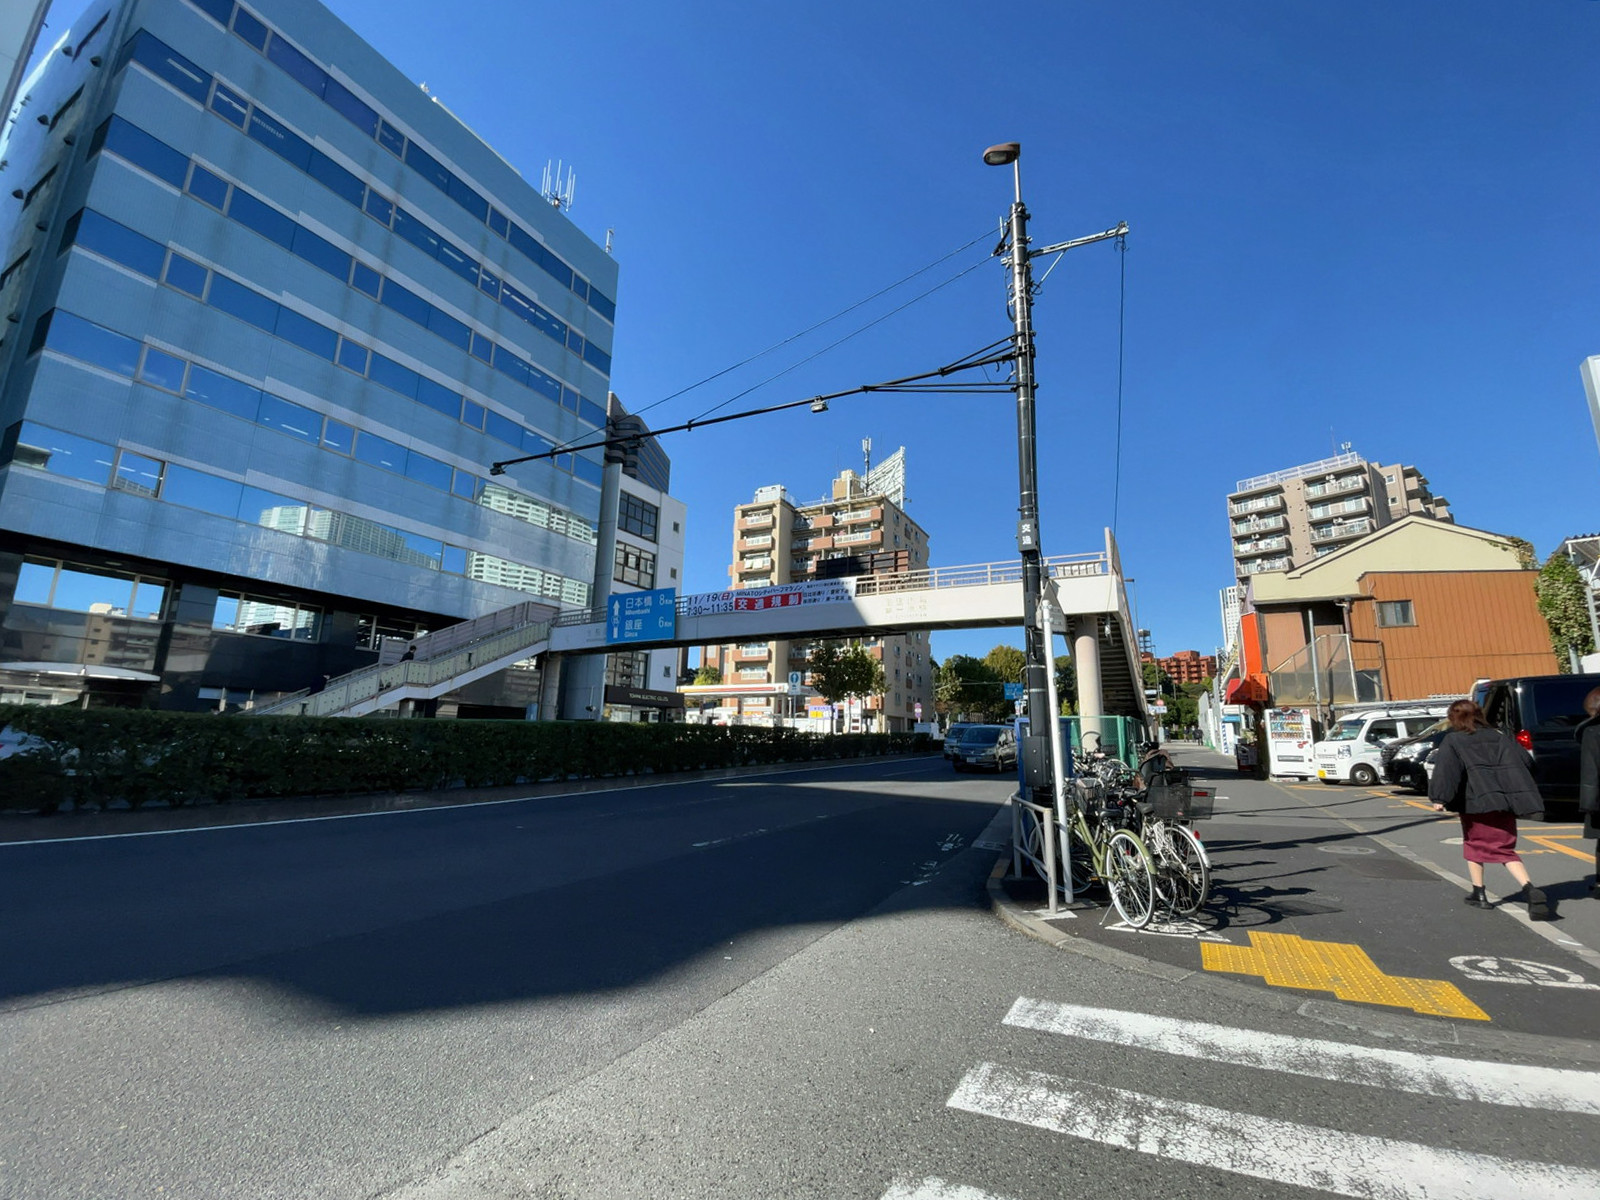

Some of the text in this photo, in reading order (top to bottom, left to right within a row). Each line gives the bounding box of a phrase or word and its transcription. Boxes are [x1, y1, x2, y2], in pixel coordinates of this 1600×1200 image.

[625, 596, 653, 609] 日本橋
[737, 594, 799, 610] 交通規制
[625, 619, 643, 630] 銀座
